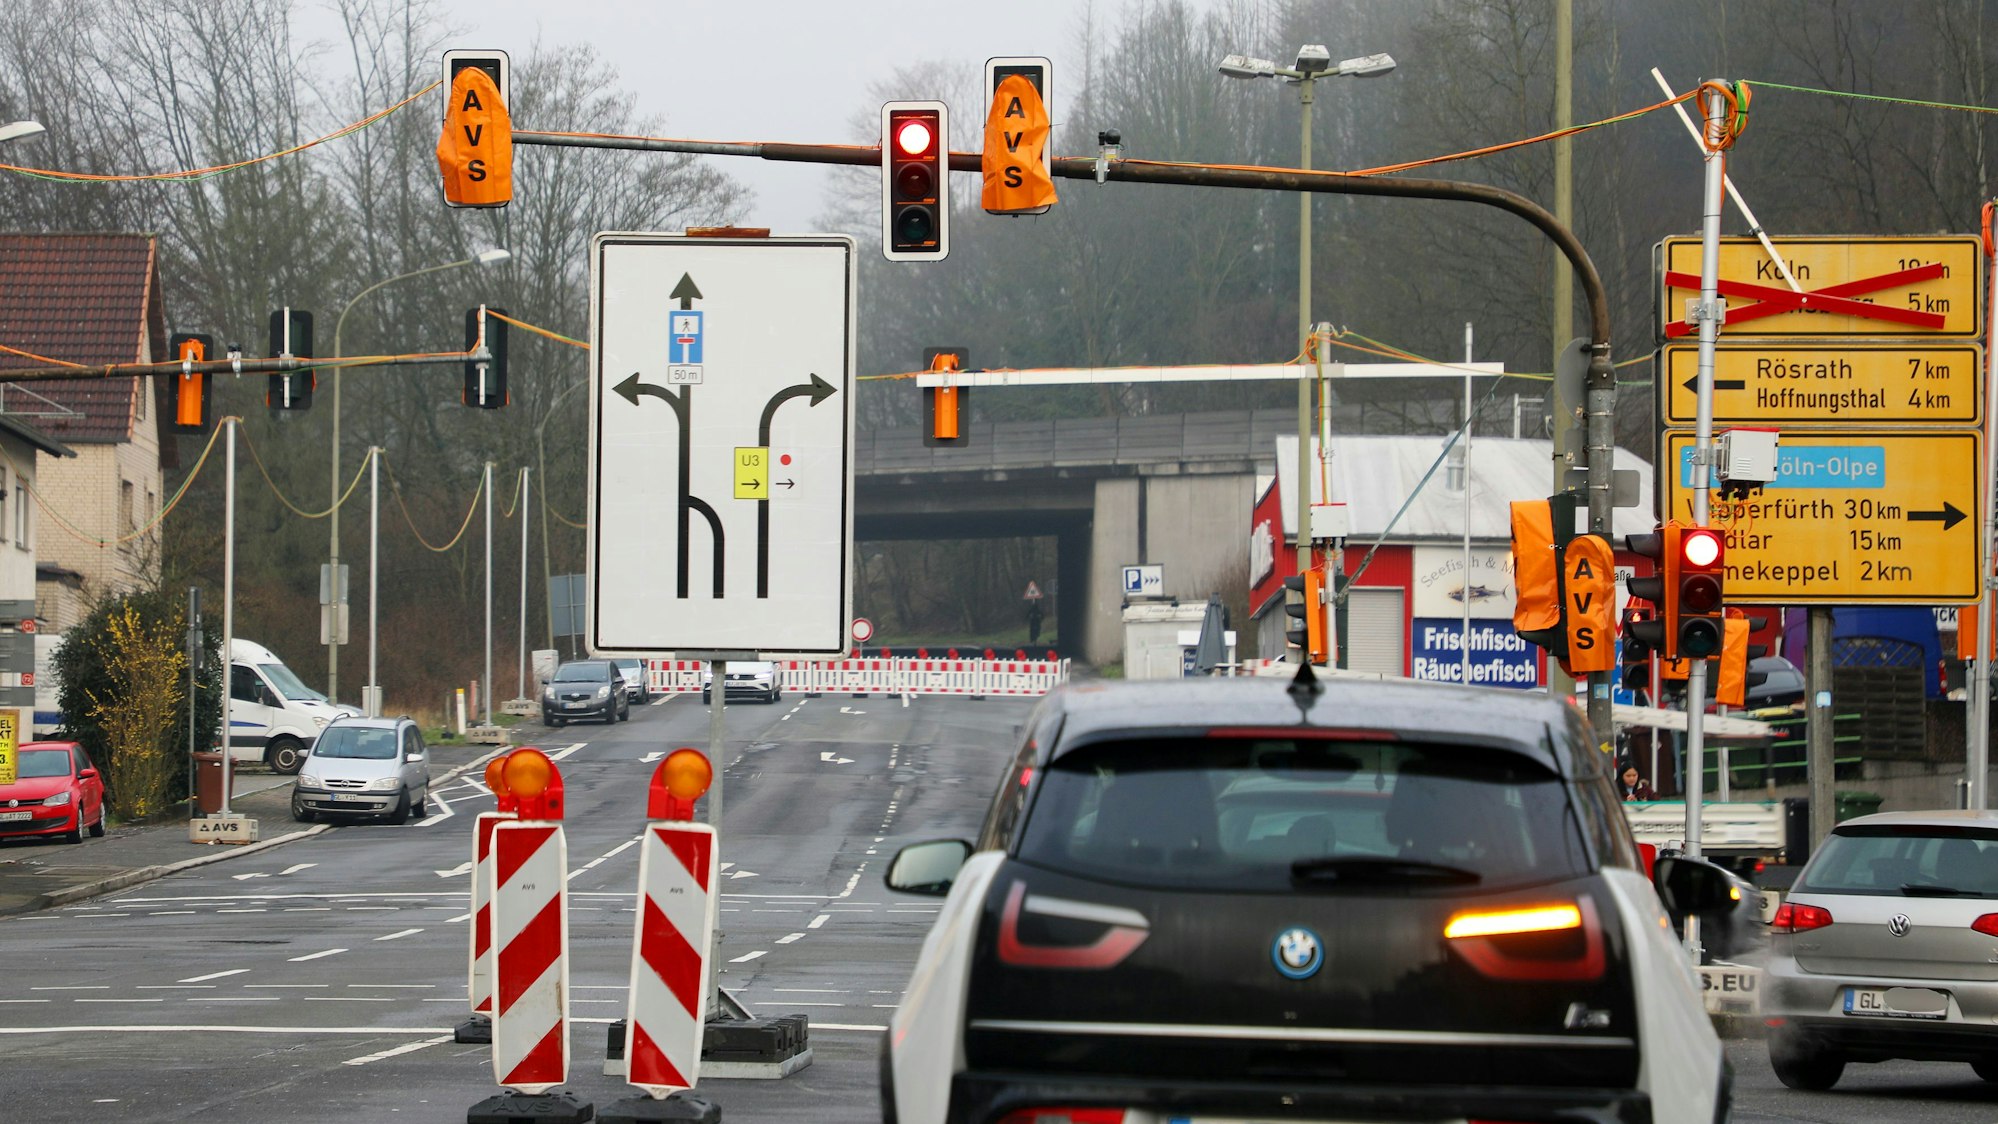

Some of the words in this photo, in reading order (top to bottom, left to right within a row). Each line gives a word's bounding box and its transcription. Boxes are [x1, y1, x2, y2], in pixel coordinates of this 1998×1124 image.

[462, 89, 487, 182] AVS
[1004, 96, 1026, 189] AVS
[1908, 292, 1921, 312] 5
[1926, 294, 1951, 313] km
[673, 370, 687, 381] 50
[688, 373, 698, 381] m
[1757, 358, 1853, 380] Rösrath
[1908, 359, 1921, 379] 7
[1926, 360, 1951, 379] km
[1757, 388, 1886, 413] Hoffnungsthal
[1908, 389, 1921, 408] 4
[1926, 390, 1951, 409] km
[741, 454, 760, 467] U3
[1780, 456, 1878, 480] öln-Olpe
[1844, 498, 1873, 520] 30
[1877, 501, 1901, 519] km
[1725, 530, 1773, 550] dlar
[1850, 529, 1873, 550] 15
[1877, 531, 1902, 550] km
[1420, 555, 1480, 588] Seefish
[1485, 556, 1497, 569] &
[1722, 560, 1839, 586] mekeppel
[1860, 560, 1873, 581] 2
[1878, 560, 1912, 581] km
[1573, 557, 1595, 650] AVS
[1423, 627, 1526, 652] Frischfisch
[1413, 656, 1536, 683] Räucherfisch
[0, 719, 12, 729] EL
[212, 823, 239, 832] AVS
[1701, 973, 1756, 992] S.EU
[492, 1101, 553, 1113] AVS
